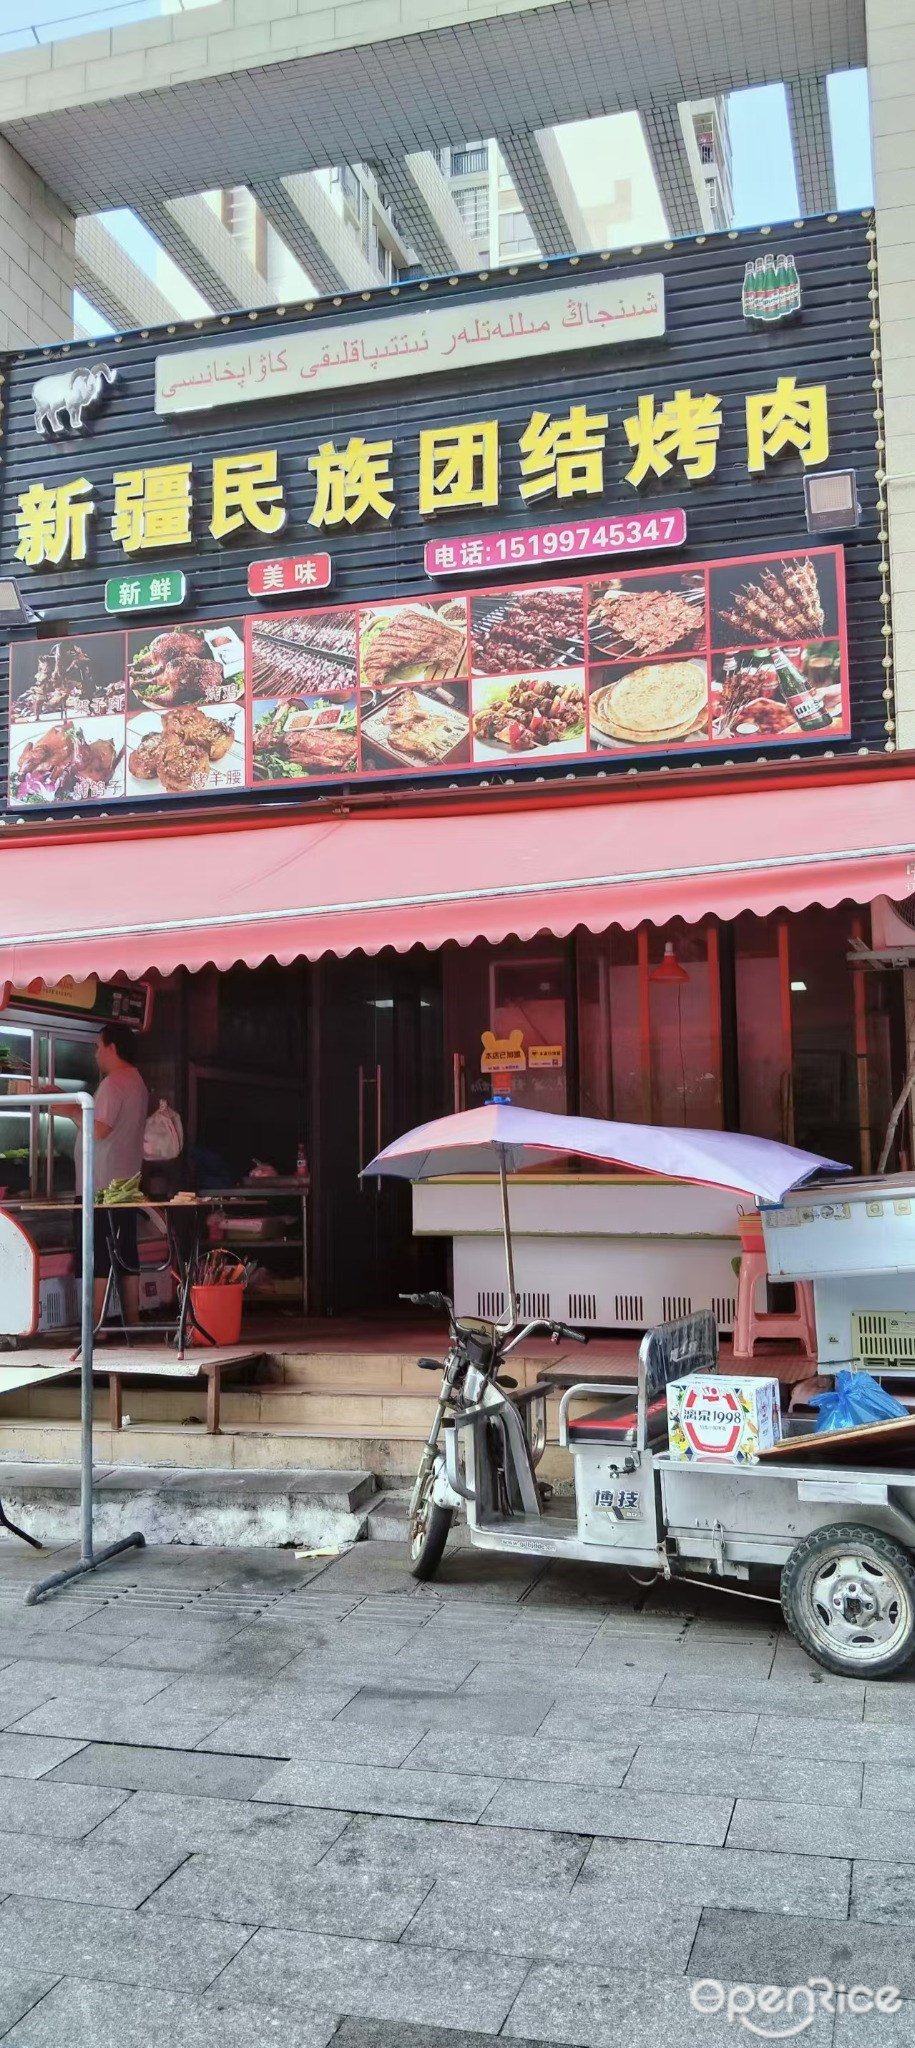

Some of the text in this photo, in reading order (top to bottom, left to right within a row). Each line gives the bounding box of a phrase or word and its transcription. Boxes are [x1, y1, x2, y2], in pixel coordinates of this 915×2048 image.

[13, 376, 830, 566] 新疆民族团结烤肉
[433, 516, 677, 568] 电话:15199745347
[262, 561, 318, 590] 美味
[118, 577, 172, 606] 新鲜
[205, 683, 239, 702] 烤鸡
[73, 779, 122, 799] 烤鸽子
[191, 769, 242, 788] 烤羊腰
[594, 1489, 639, 1508] 博技
